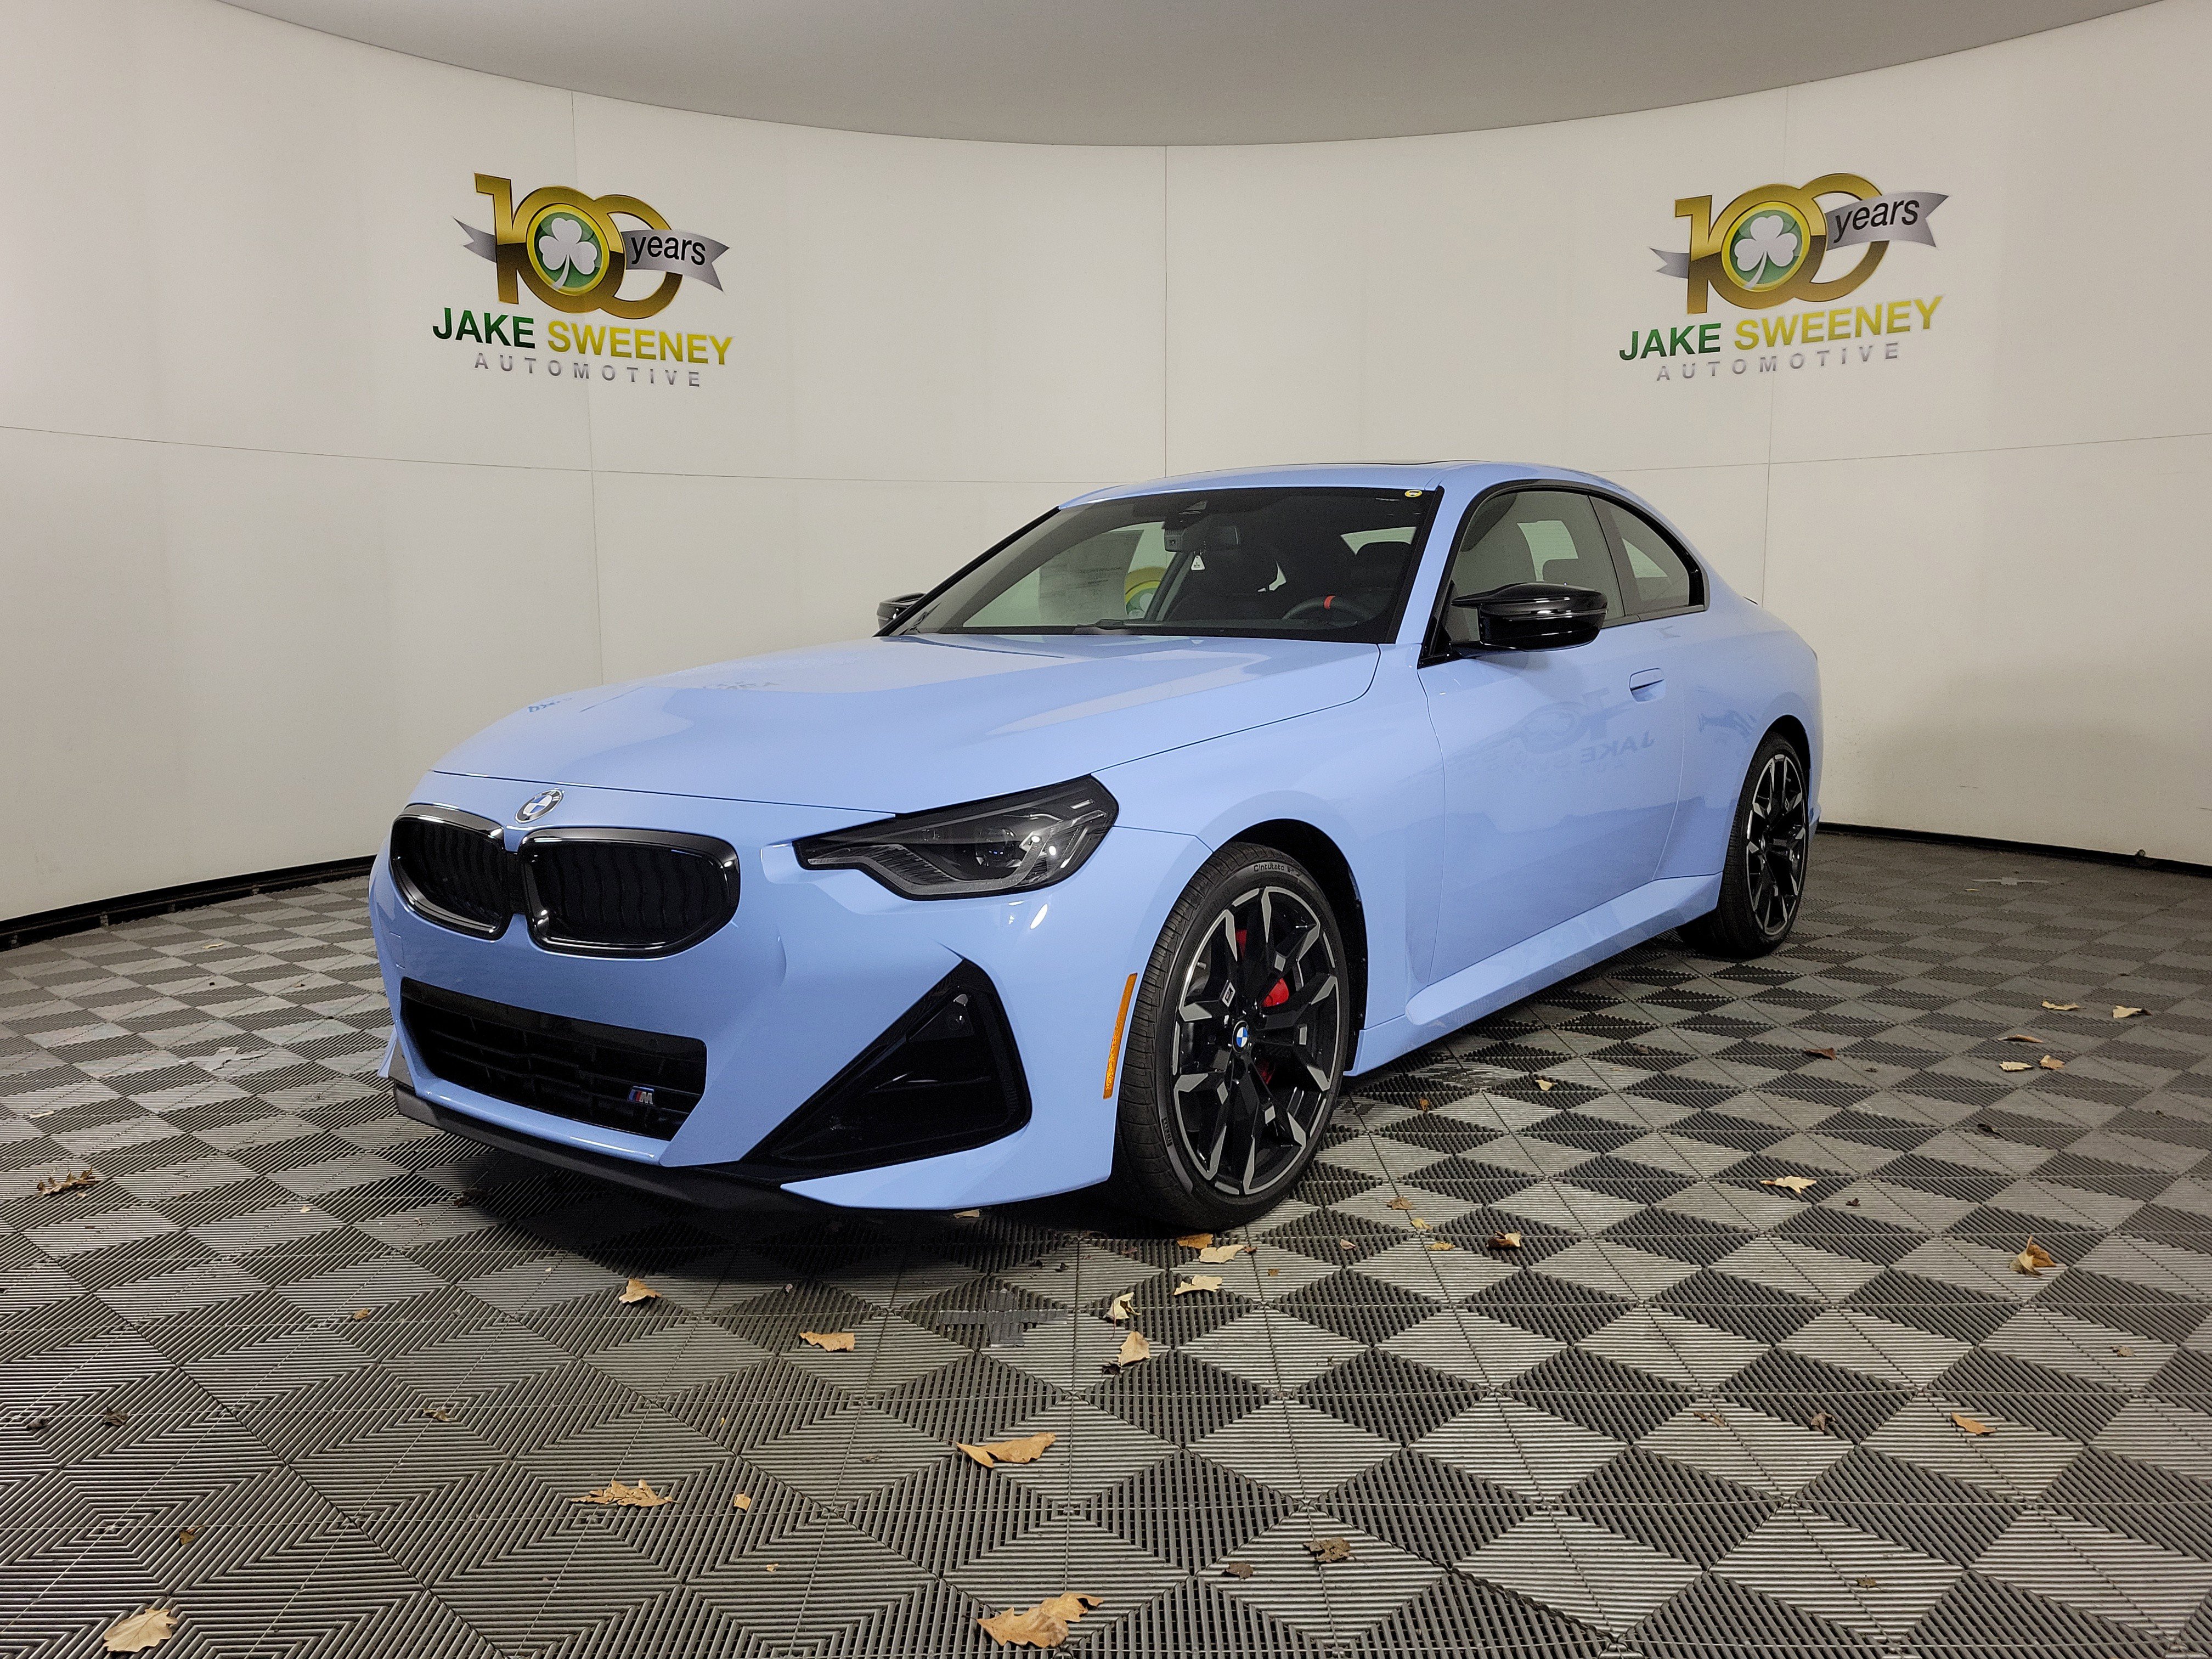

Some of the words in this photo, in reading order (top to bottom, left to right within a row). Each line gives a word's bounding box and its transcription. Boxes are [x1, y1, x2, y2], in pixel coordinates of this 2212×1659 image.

[474, 172, 684, 320] 100
[631, 236, 706, 266] years
[1674, 173, 1891, 314] 100
[1833, 200, 1920, 244] years
[432, 307, 535, 349] JAKE
[548, 320, 733, 365] SWEENEY
[1619, 323, 1722, 361] JAKE
[1734, 296, 1944, 351] SWEENEY
[474, 352, 700, 387] AUTOMOTIVE
[1656, 342, 1898, 381] AUTOMOTIVE
[1253, 864, 1285, 872] Cinturato
